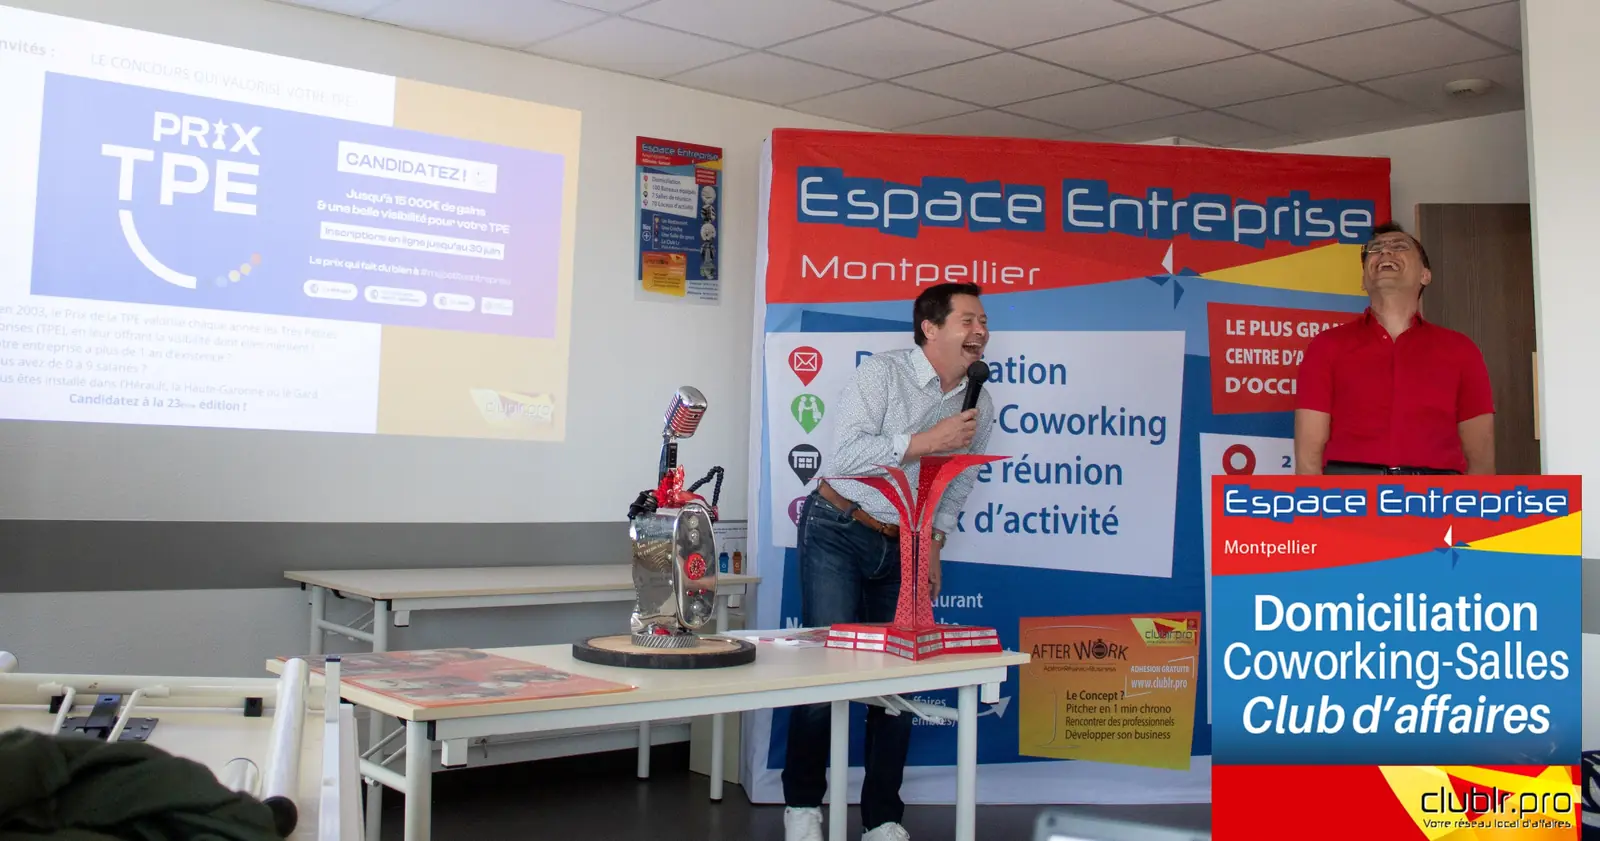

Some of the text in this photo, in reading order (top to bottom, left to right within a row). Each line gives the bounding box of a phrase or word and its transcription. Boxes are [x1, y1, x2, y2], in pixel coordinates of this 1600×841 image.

[0, 38, 46, 57] nvités
[111, 56, 189, 80] CONCOURS
[153, 110, 262, 156] PRIX
[101, 143, 260, 216] TPE
[345, 188, 487, 217] Jusqu'à 15 000€ de gains
[801, 176, 1373, 242] Espace Entreprise
[316, 199, 511, 235] & une belle visibilité pour votre TPE
[325, 226, 387, 242] Inscriptions
[388, 232, 400, 243] en
[401, 233, 426, 247] ligne
[483, 244, 501, 257] juin
[308, 255, 322, 266] Le
[322, 257, 344, 269] prix
[344, 259, 360, 272] qui
[360, 260, 377, 271] fait
[377, 262, 390, 273] du
[391, 263, 412, 275] bien
[801, 254, 1041, 287] Montpellier
[16, 304, 48, 319] 2003,
[89, 311, 104, 322] de
[121, 313, 140, 325] TPE
[0, 321, 33, 333] prises
[1225, 319, 1246, 336] LE
[1249, 319, 1293, 338] PLUS
[0, 339, 19, 350] tre
[22, 339, 82, 354] entreprise
[95, 344, 118, 356] plus
[121, 346, 136, 357] de
[1225, 347, 1304, 366] CENTRE D'A
[0, 357, 15, 366] us
[17, 358, 44, 368] avez
[47, 358, 63, 369] de
[96, 360, 138, 373] salariés
[0, 374, 14, 383] us
[17, 373, 42, 385] êtes
[45, 376, 86, 387] installé
[89, 377, 117, 389] dans
[184, 382, 265, 397] Haute-Garonne
[293, 387, 319, 400] Gard
[1225, 376, 1297, 395] D'OCCI
[69, 392, 139, 407] Candidatez
[153, 395, 164, 408] la
[199, 398, 240, 411] édition
[1002, 454, 1123, 486] réunion
[974, 501, 1120, 536] d'activité
[931, 592, 984, 609] aurant
[1031, 638, 1129, 661] AFTER WORK
[1130, 665, 1160, 673] ADHESION
[1131, 676, 1188, 691] www.clublr.pro
[1066, 690, 1078, 701] Le
[1079, 690, 1118, 702] Concept
[1066, 703, 1097, 714] Pitcher
[1099, 705, 1110, 714] en
[1121, 704, 1137, 714] min
[1139, 703, 1172, 714] chrono
[1065, 716, 1175, 729] Rencontrer des professionnels
[1065, 729, 1171, 742] Développer son business
